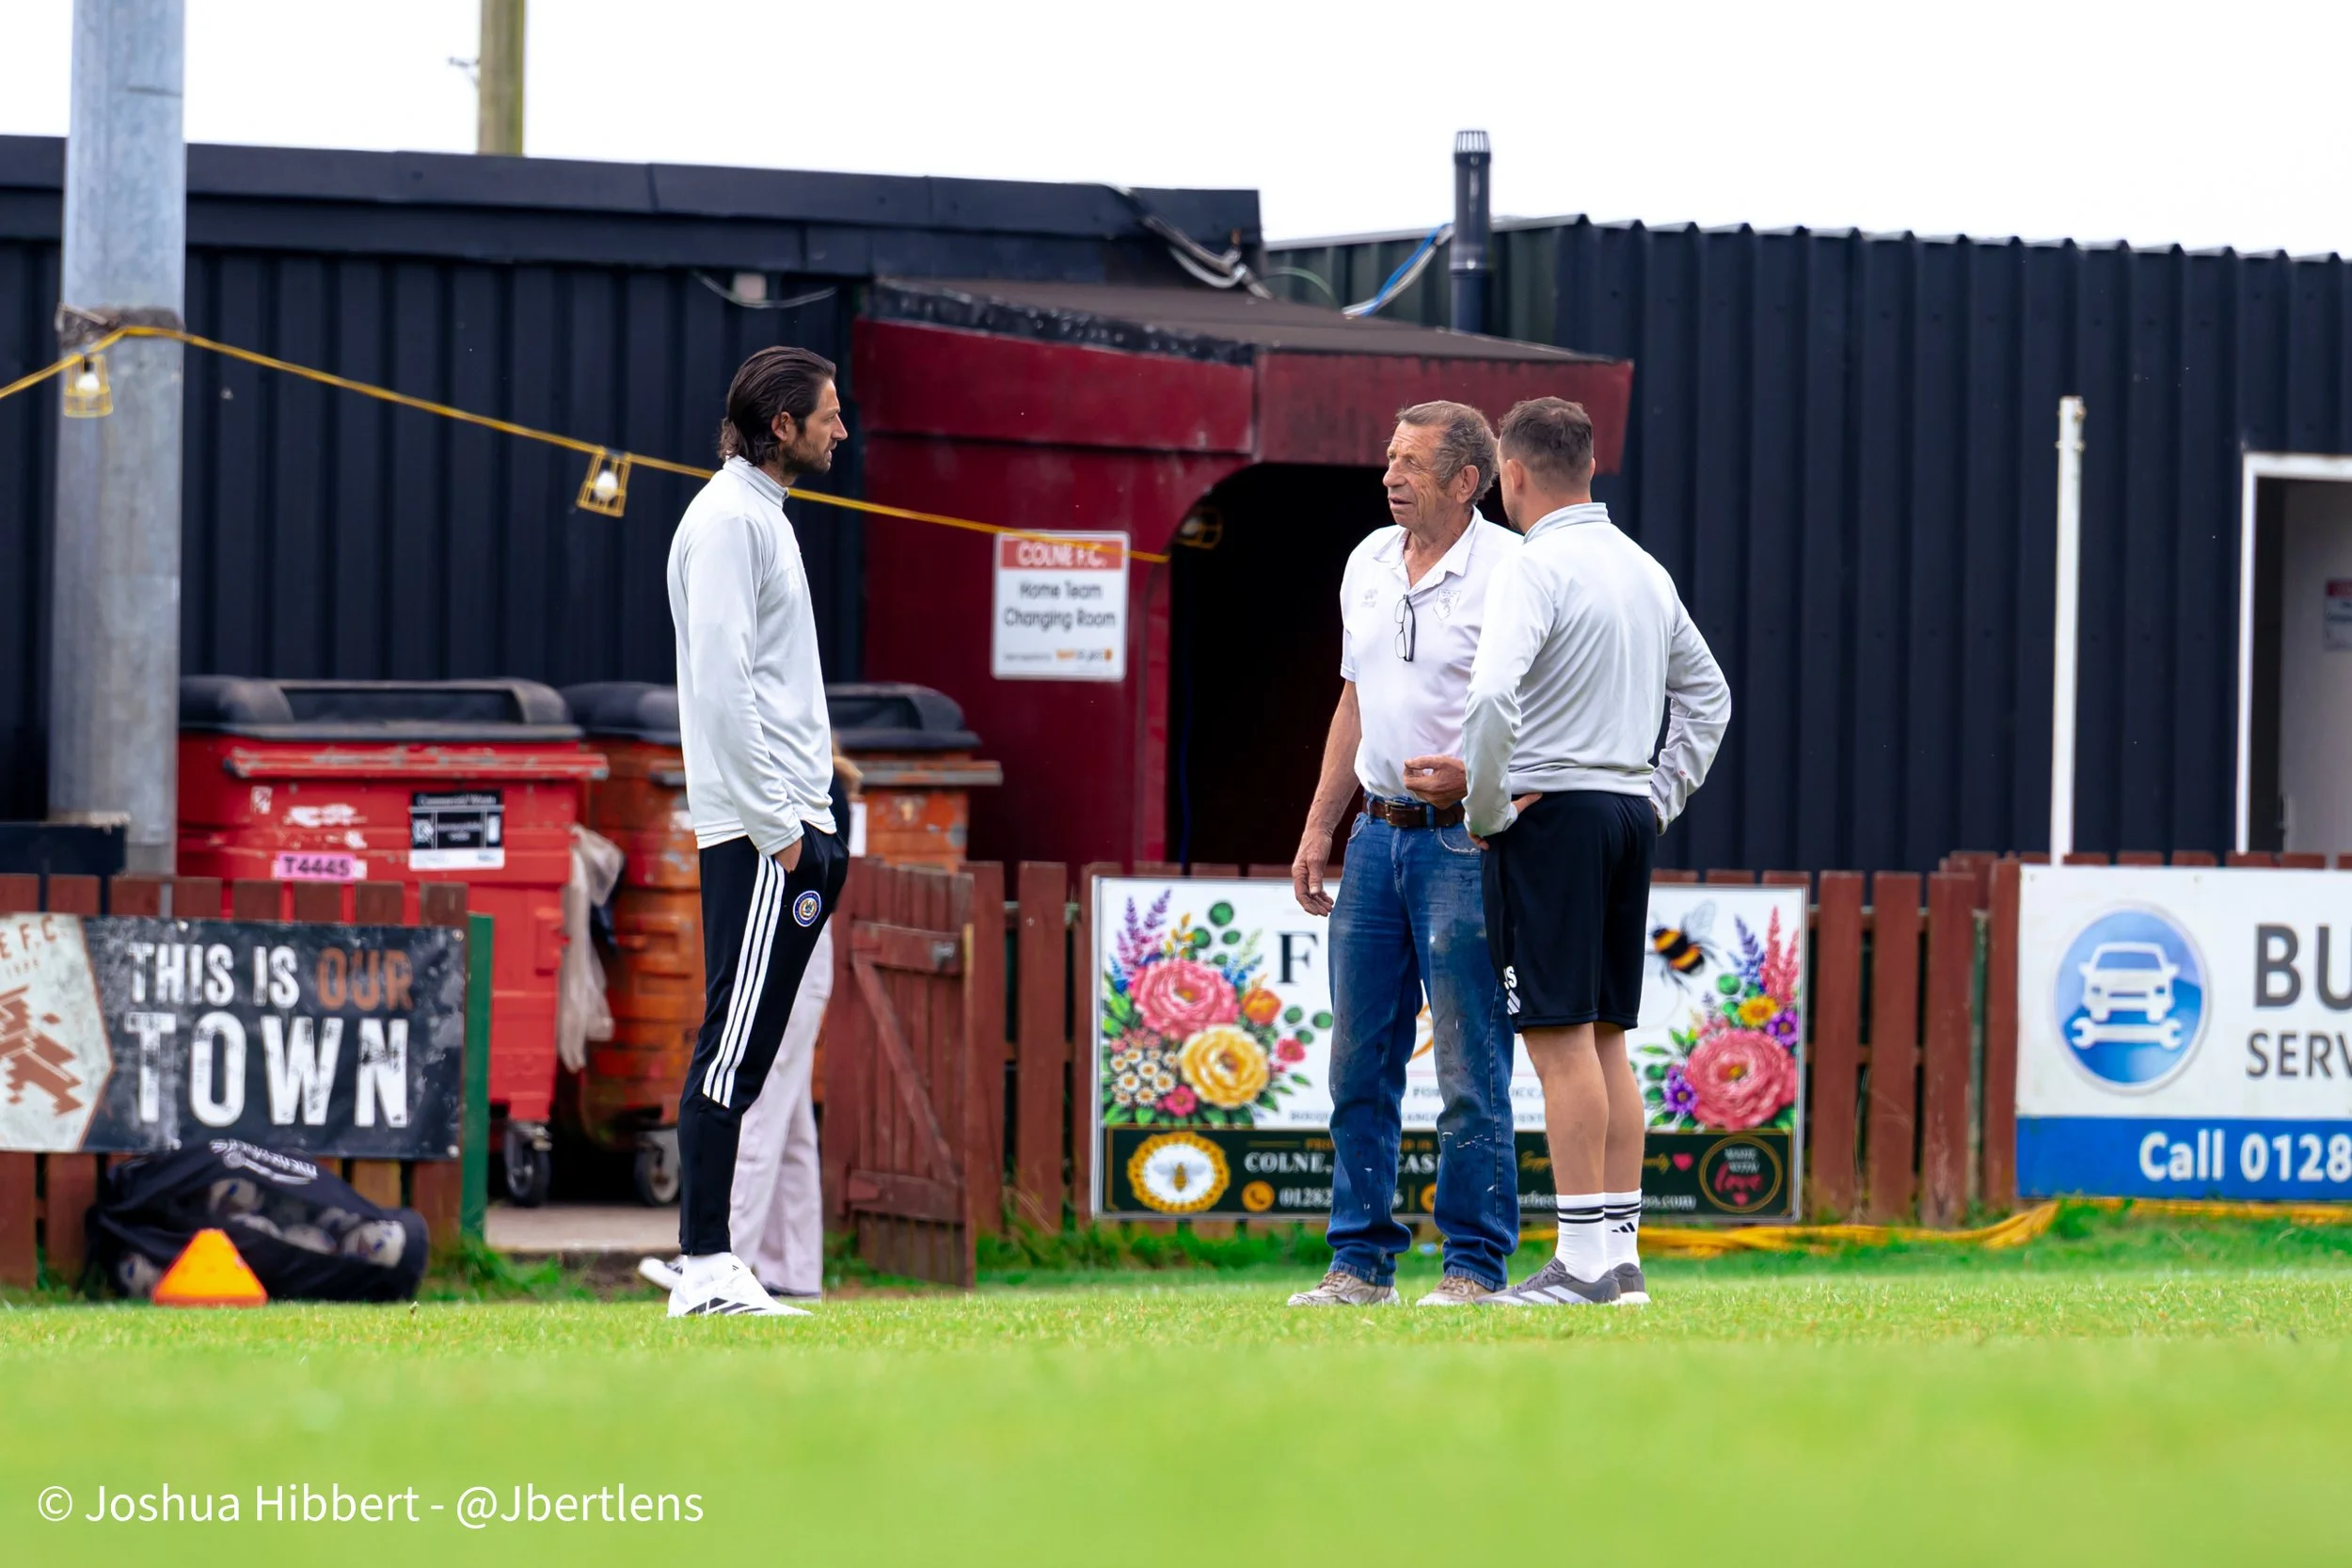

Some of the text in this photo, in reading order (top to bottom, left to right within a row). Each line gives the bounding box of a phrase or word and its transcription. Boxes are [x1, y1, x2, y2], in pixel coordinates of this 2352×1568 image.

[1019, 579, 1103, 599] Home Team
[1004, 606, 1117, 633] Changing Room
[284, 856, 351, 877] T4445
[127, 942, 413, 1011] THIS IS OUR
[123, 1011, 408, 1128] TOWN
[2137, 1127, 2352, 1183] Call 0128
